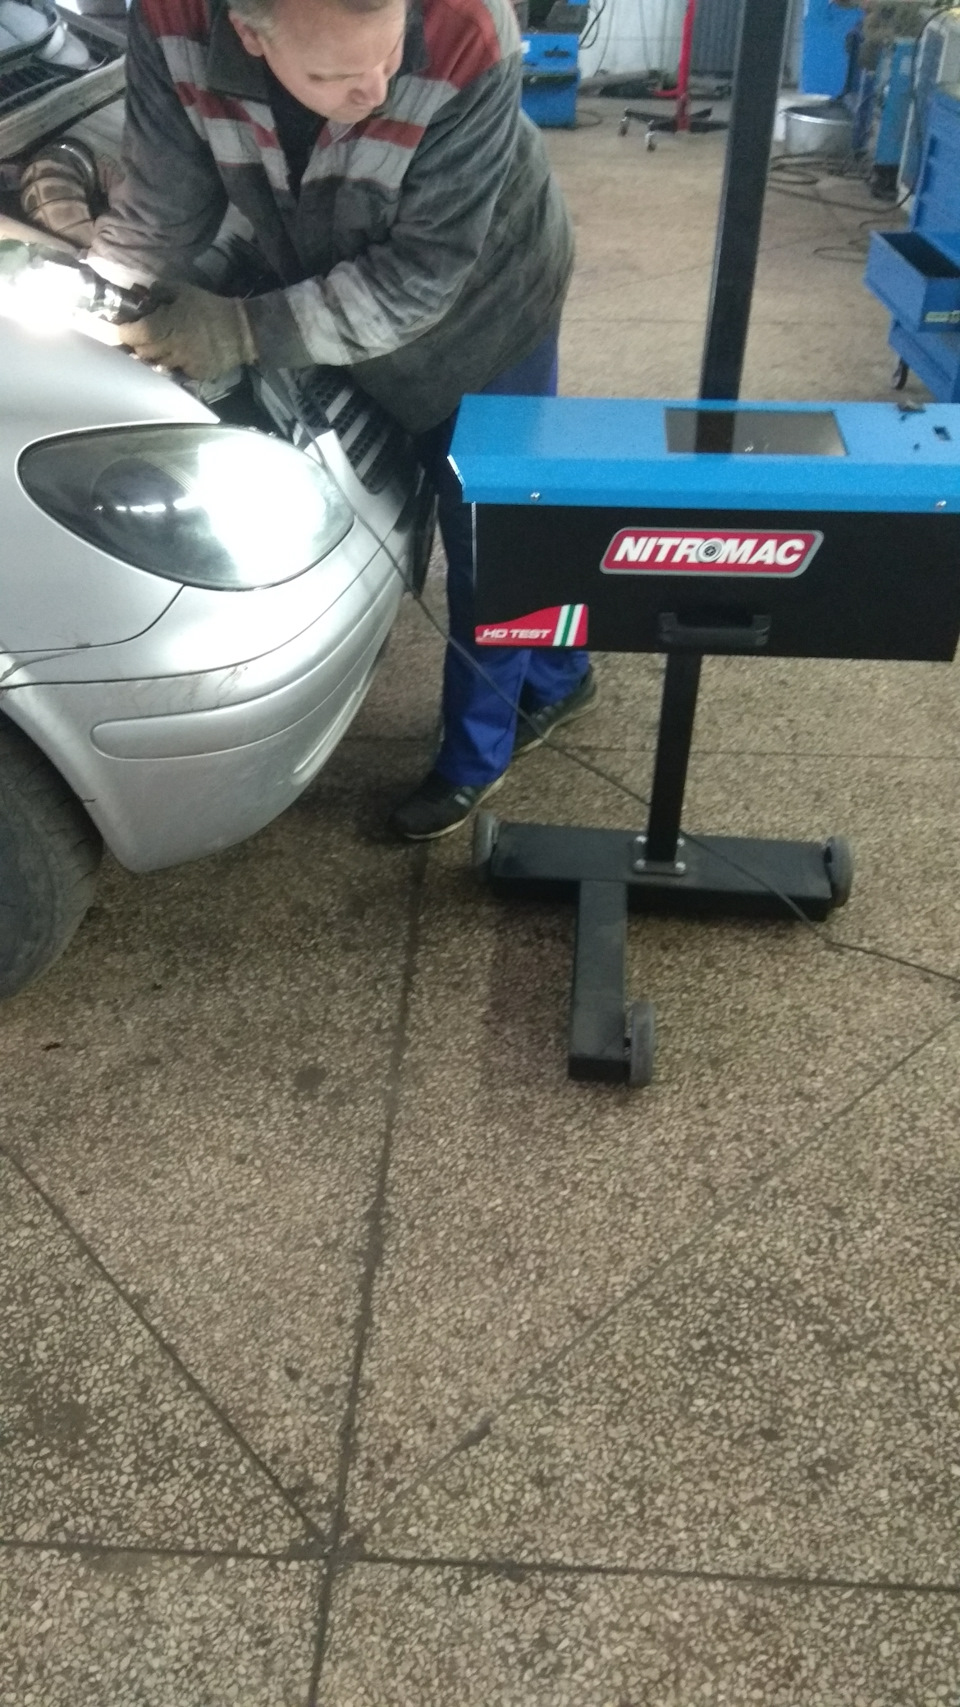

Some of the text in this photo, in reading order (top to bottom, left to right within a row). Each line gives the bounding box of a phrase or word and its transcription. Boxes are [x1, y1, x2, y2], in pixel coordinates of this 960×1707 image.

[613, 536, 805, 566] NITROMAC
[482, 628, 552, 639] HD TEST
